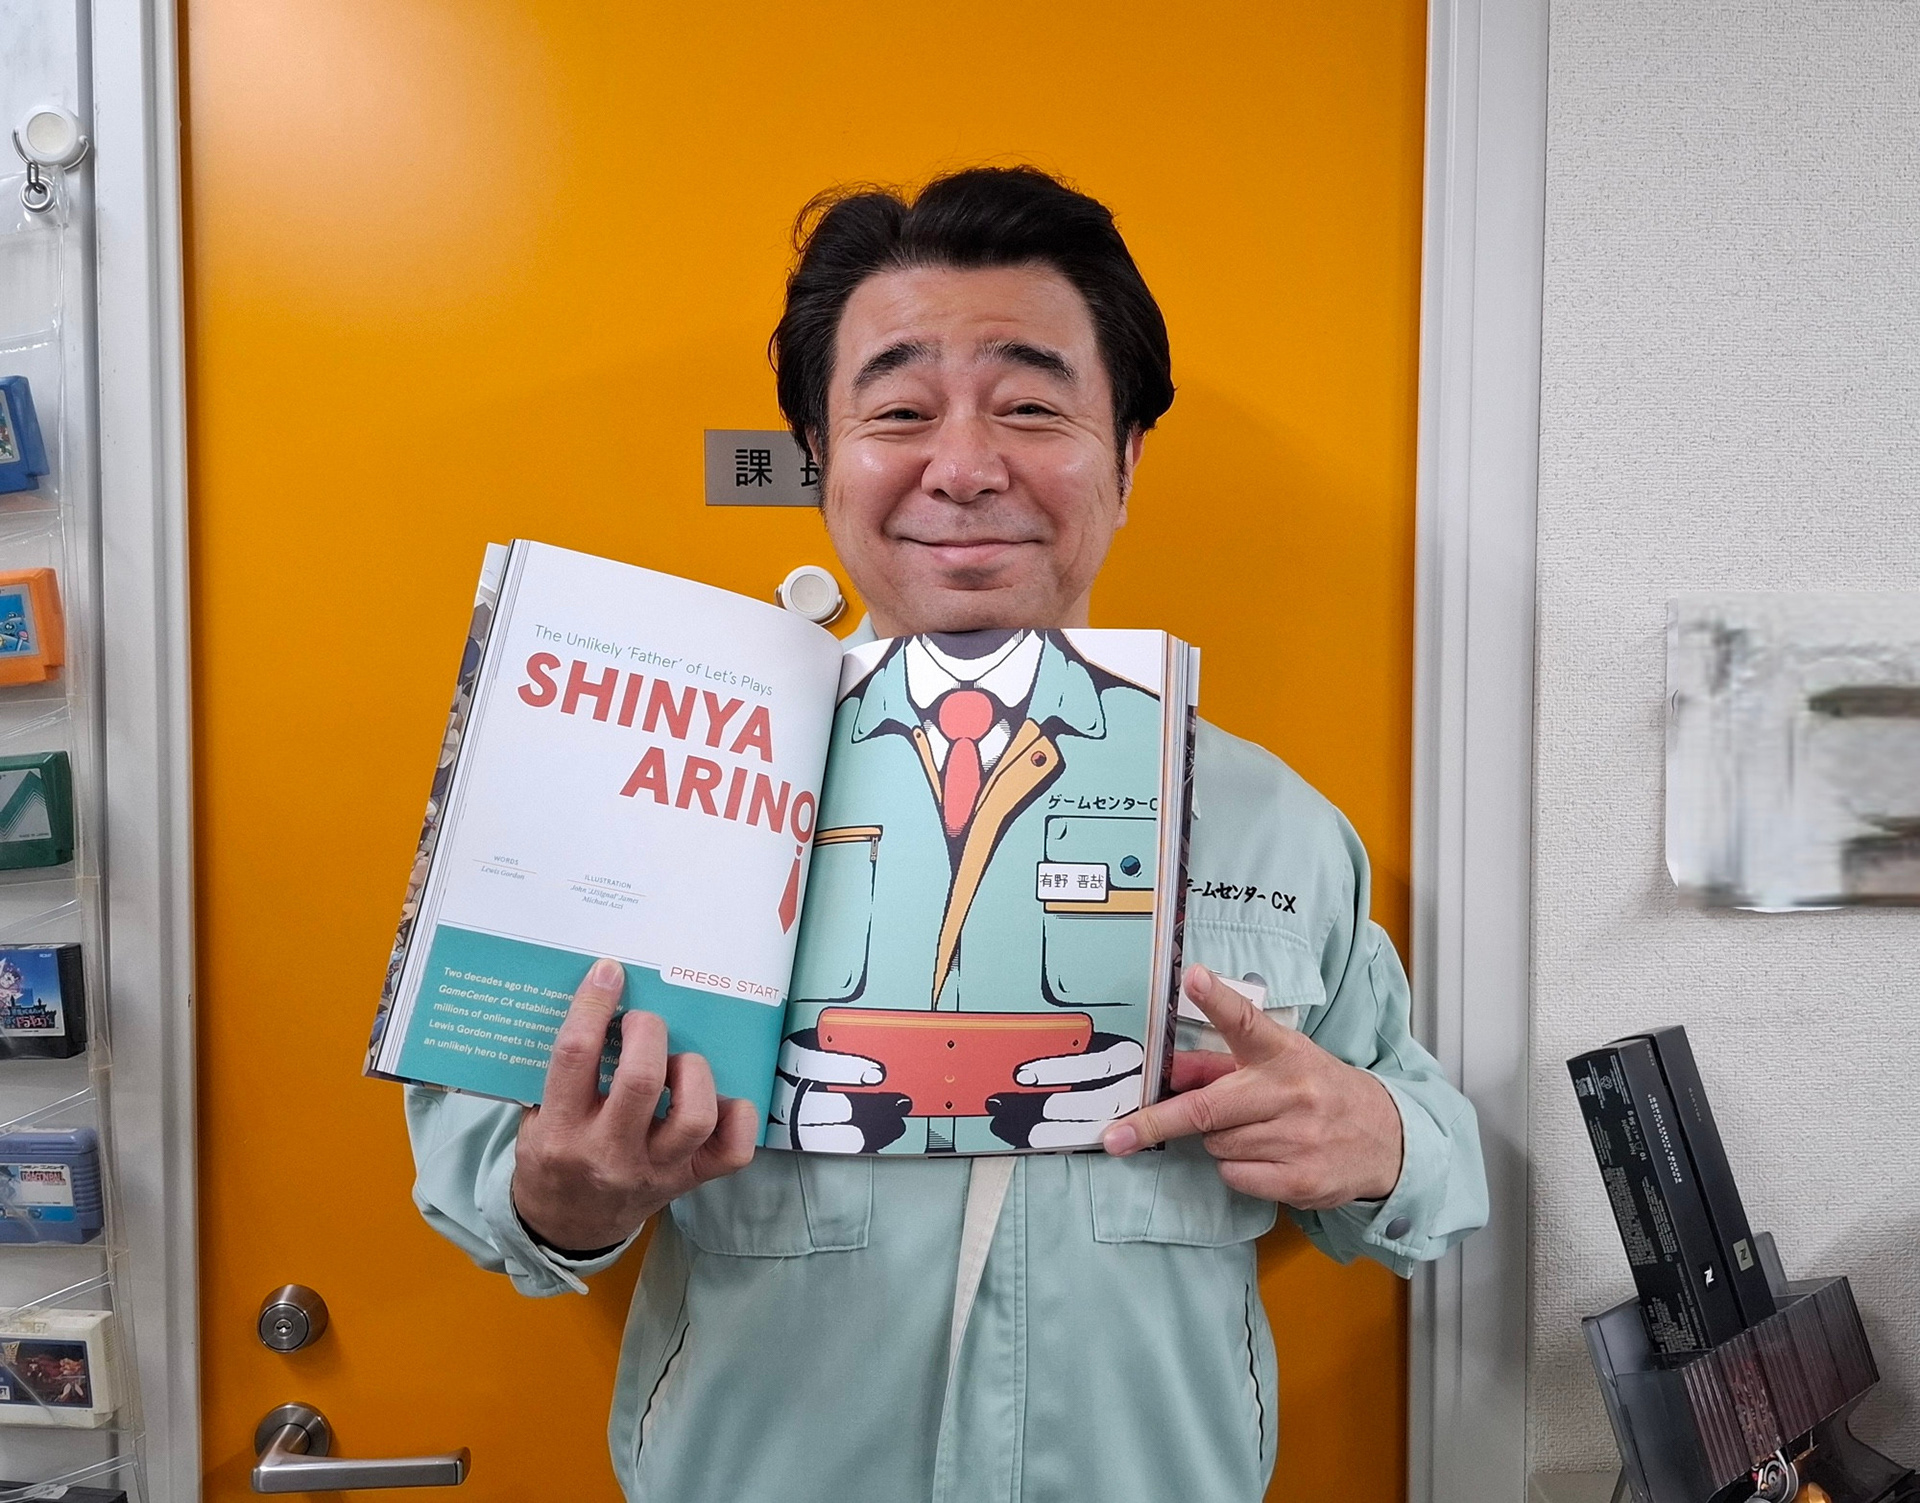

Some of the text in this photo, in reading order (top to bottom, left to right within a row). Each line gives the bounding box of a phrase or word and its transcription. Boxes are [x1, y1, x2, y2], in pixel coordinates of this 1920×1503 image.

[535, 624, 562, 642] The
[566, 632, 623, 658] Unlikely
[686, 663, 702, 675] of
[705, 665, 737, 685] Let's
[741, 675, 773, 696] Plays
[517, 652, 773, 763] SHINYA
[619, 746, 816, 843] ARINO
[481, 865, 525, 881] Lewis Gordon
[493, 855, 519, 866] WORDS
[570, 884, 587, 894] John
[618, 893, 639, 904] James
[584, 874, 632, 889] ILLUSTRATION
[1040, 873, 1068, 888] 有野
[582, 896, 623, 910] Michael Azzi
[1271, 891, 1297, 914] CX
[444, 966, 574, 1001] Two decades ago the Japane
[670, 966, 780, 1000] PRESS START
[439, 984, 567, 1018] GameCenter CX established
[433, 1002, 560, 1035] millions of online streamers
[429, 1018, 553, 1052] Lewis Gordon meets its hos
[423, 1037, 549, 1069] an unlikely hero to generati
